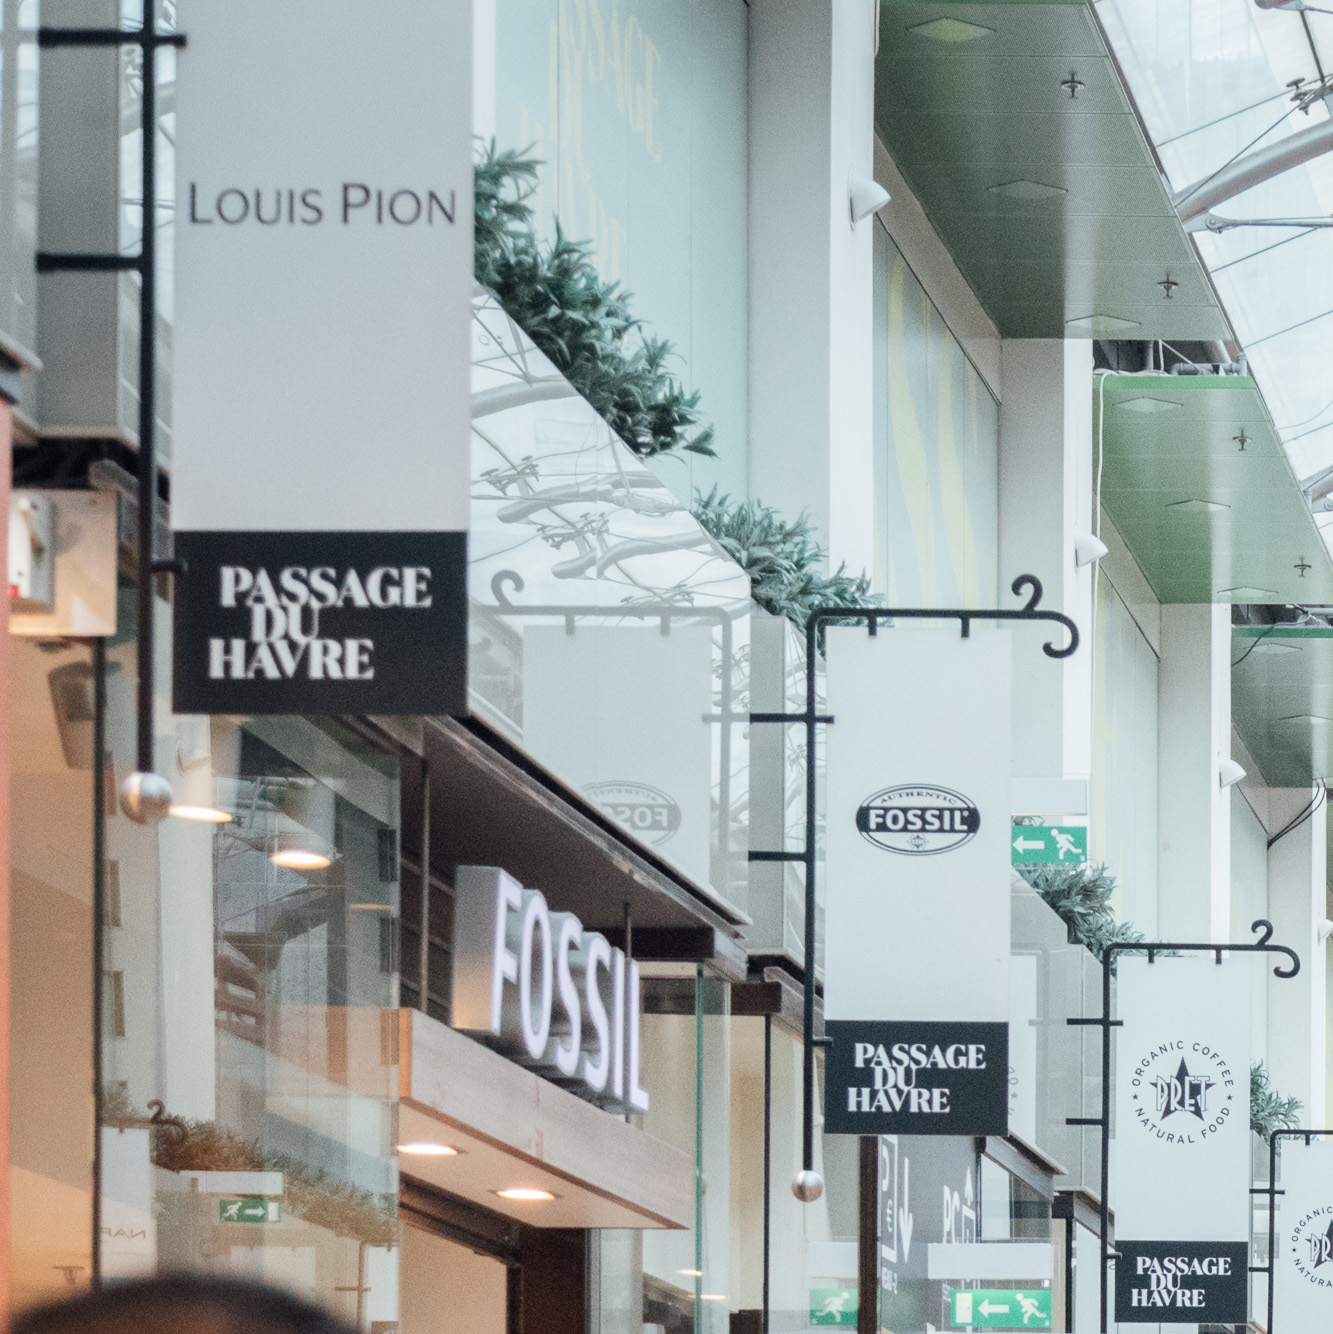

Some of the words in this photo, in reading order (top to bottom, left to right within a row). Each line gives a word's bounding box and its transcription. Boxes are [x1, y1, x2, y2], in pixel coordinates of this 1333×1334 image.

[188, 182, 324, 227] LOUIS
[340, 182, 457, 227] PION
[222, 567, 431, 610] PASSAGE
[252, 603, 318, 644] DU
[210, 639, 374, 679] HAVRE
[879, 789, 958, 806] AUTHENTIC
[868, 808, 968, 832] FOSSIL
[490, 868, 650, 1113] FOSSIL
[855, 1043, 986, 1069] PASSAGE
[1132, 1040, 1184, 1088] ORGANIC
[1192, 1042, 1235, 1088] COFFEE
[875, 1065, 915, 1091] DU
[1156, 1075, 1211, 1112] PRET
[848, 1087, 950, 1112] HAVRE
[1135, 1107, 1195, 1144] NATURAL
[1201, 1106, 1231, 1139] FOOD
[1291, 1206, 1333, 1242] ORGANIC
[1137, 1257, 1231, 1276] PASSAGE
[1151, 1273, 1180, 1292] DU
[1132, 1289, 1205, 1307] HAVRE
